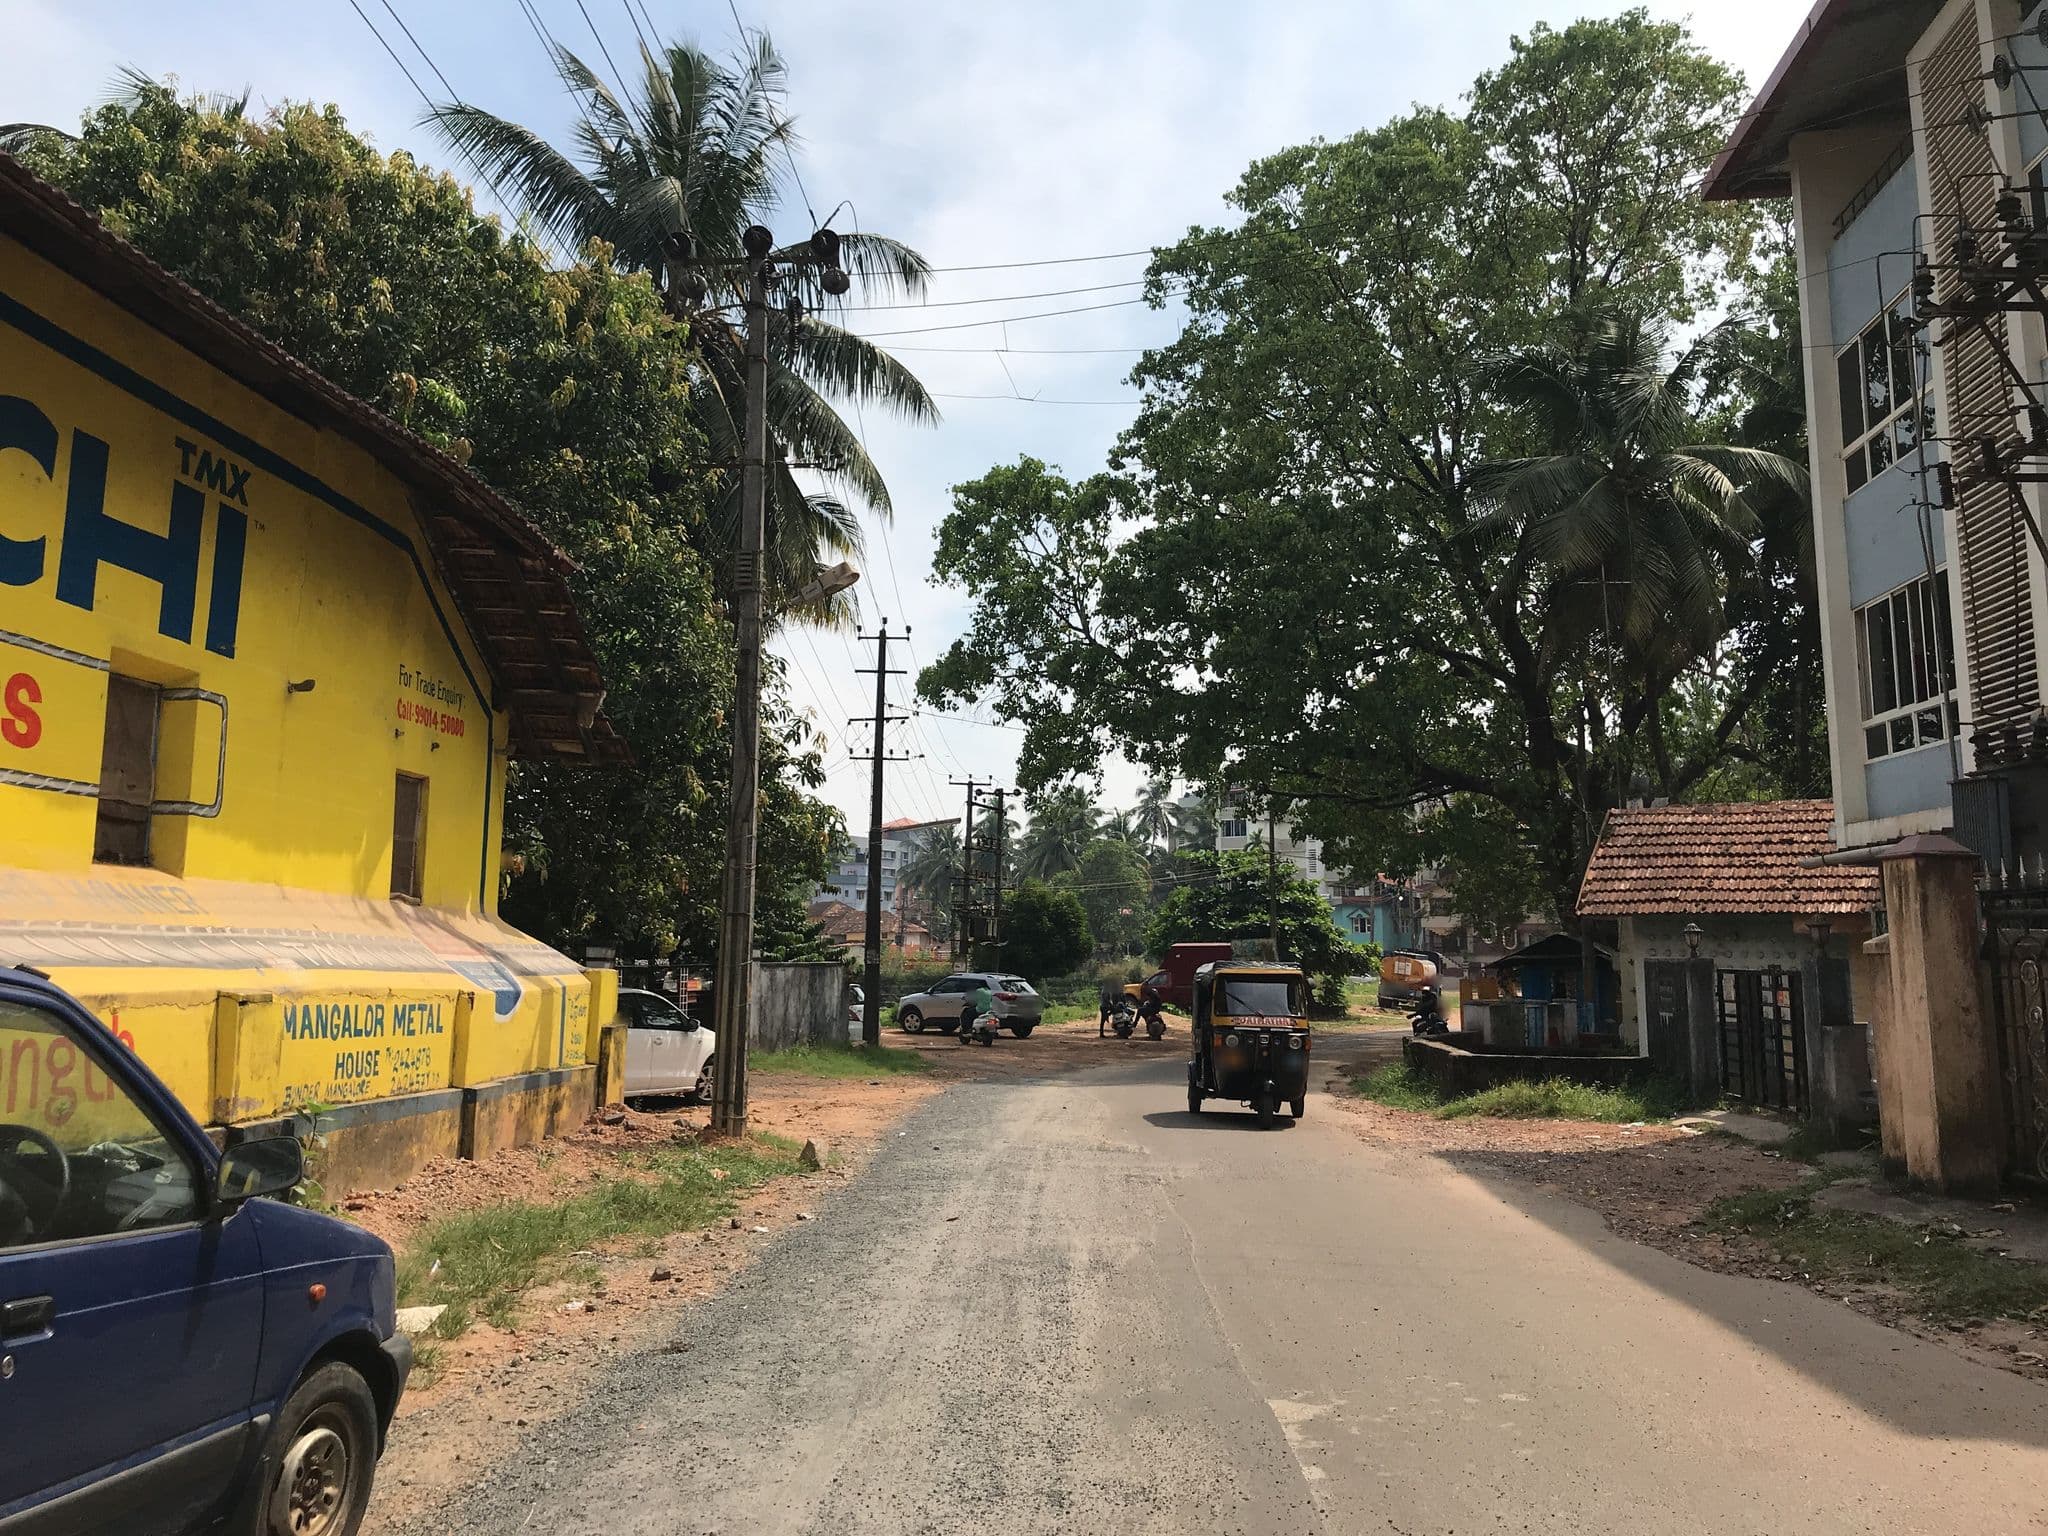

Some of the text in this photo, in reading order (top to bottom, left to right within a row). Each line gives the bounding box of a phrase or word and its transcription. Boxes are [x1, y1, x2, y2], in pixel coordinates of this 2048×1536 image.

[175, 436, 251, 506] TMX
[399, 664, 412, 687] For
[416, 670, 436, 697] Trade
[284, 1003, 443, 1040] MANGALOR METAL
[334, 1050, 380, 1080] HOUSE
